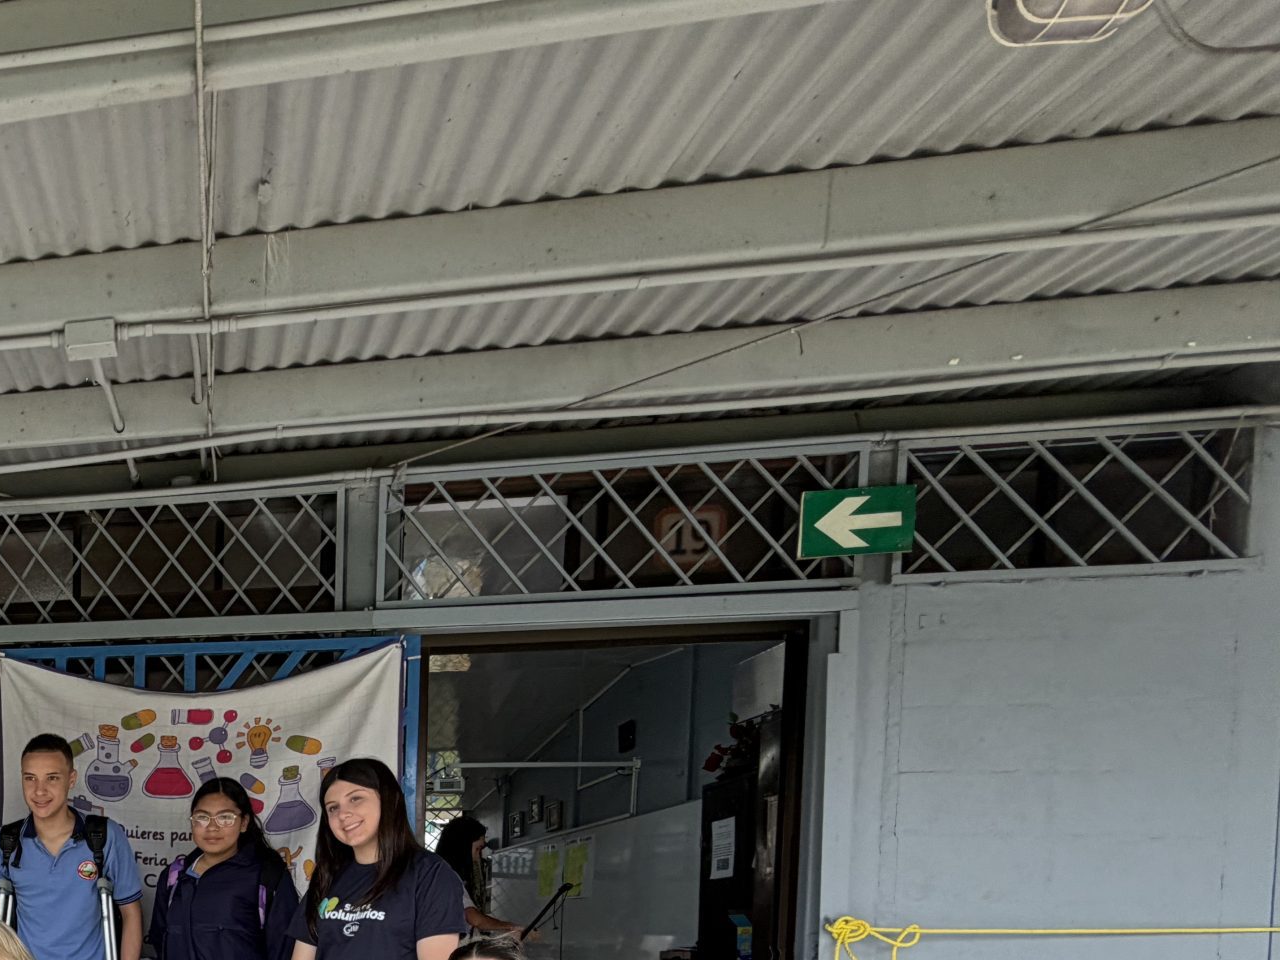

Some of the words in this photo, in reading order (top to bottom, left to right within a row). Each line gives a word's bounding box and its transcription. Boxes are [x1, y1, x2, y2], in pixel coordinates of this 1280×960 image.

[669, 519, 712, 555] 19
[170, 831, 193, 848] par
[134, 851, 169, 867] Feria
